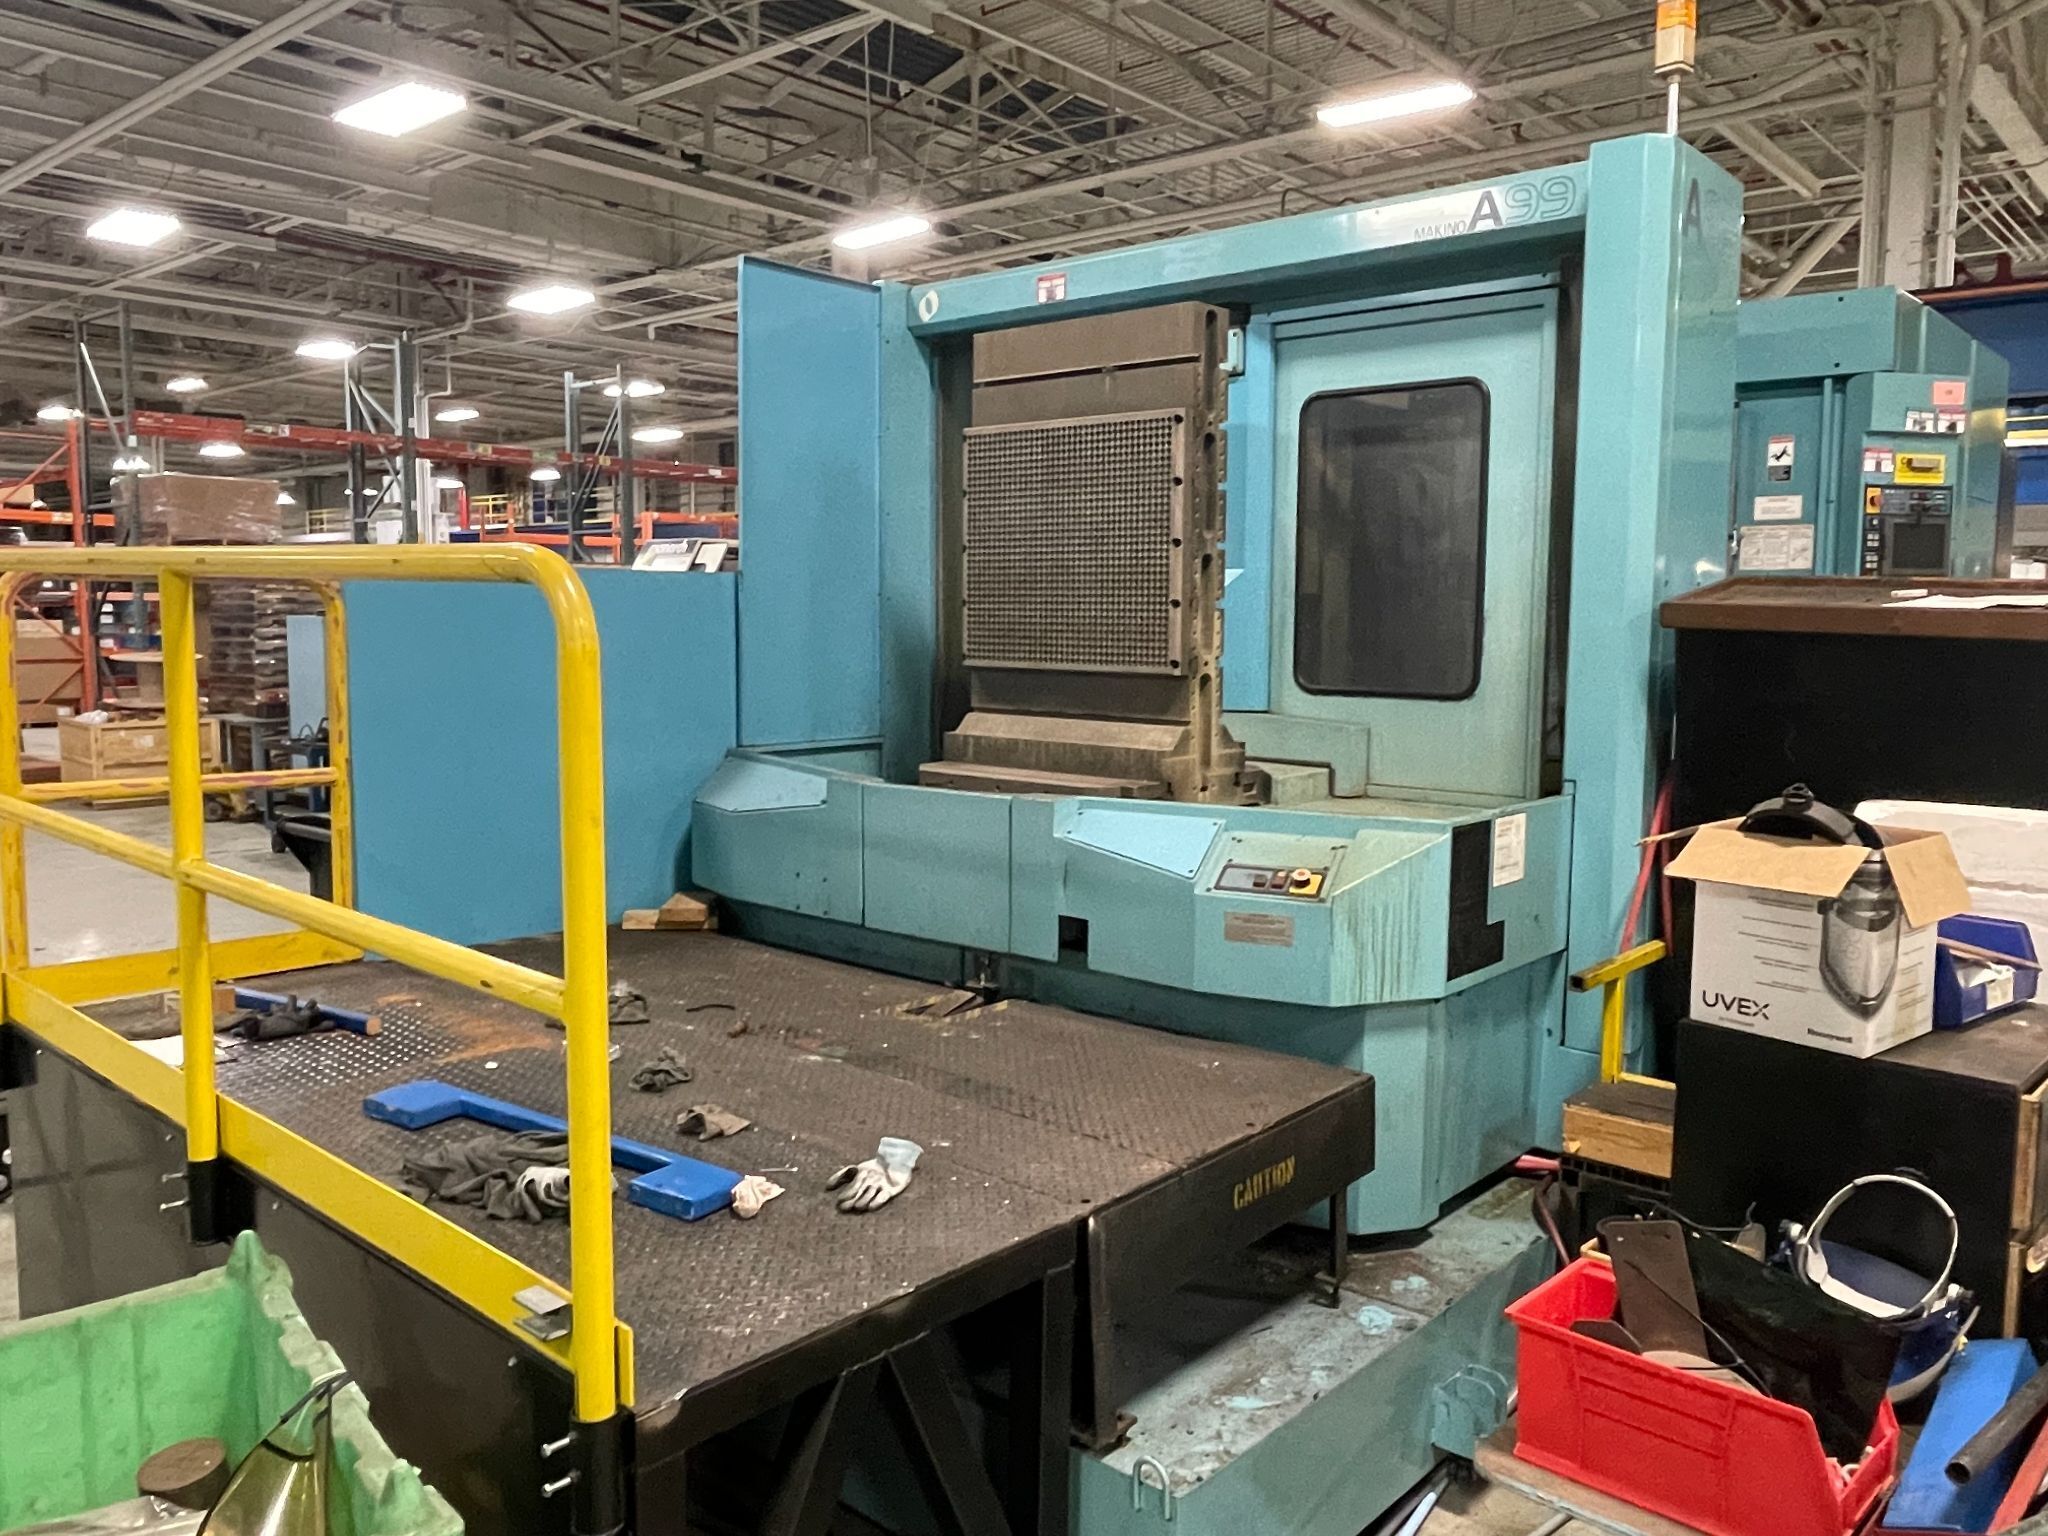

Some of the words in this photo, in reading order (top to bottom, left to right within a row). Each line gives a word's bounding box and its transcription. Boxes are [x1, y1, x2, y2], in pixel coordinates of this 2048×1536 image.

[1413, 219, 1467, 242] MAKINO
[1702, 990, 1770, 1020] UVEX
[1233, 1154, 1296, 1211] CAUTION
